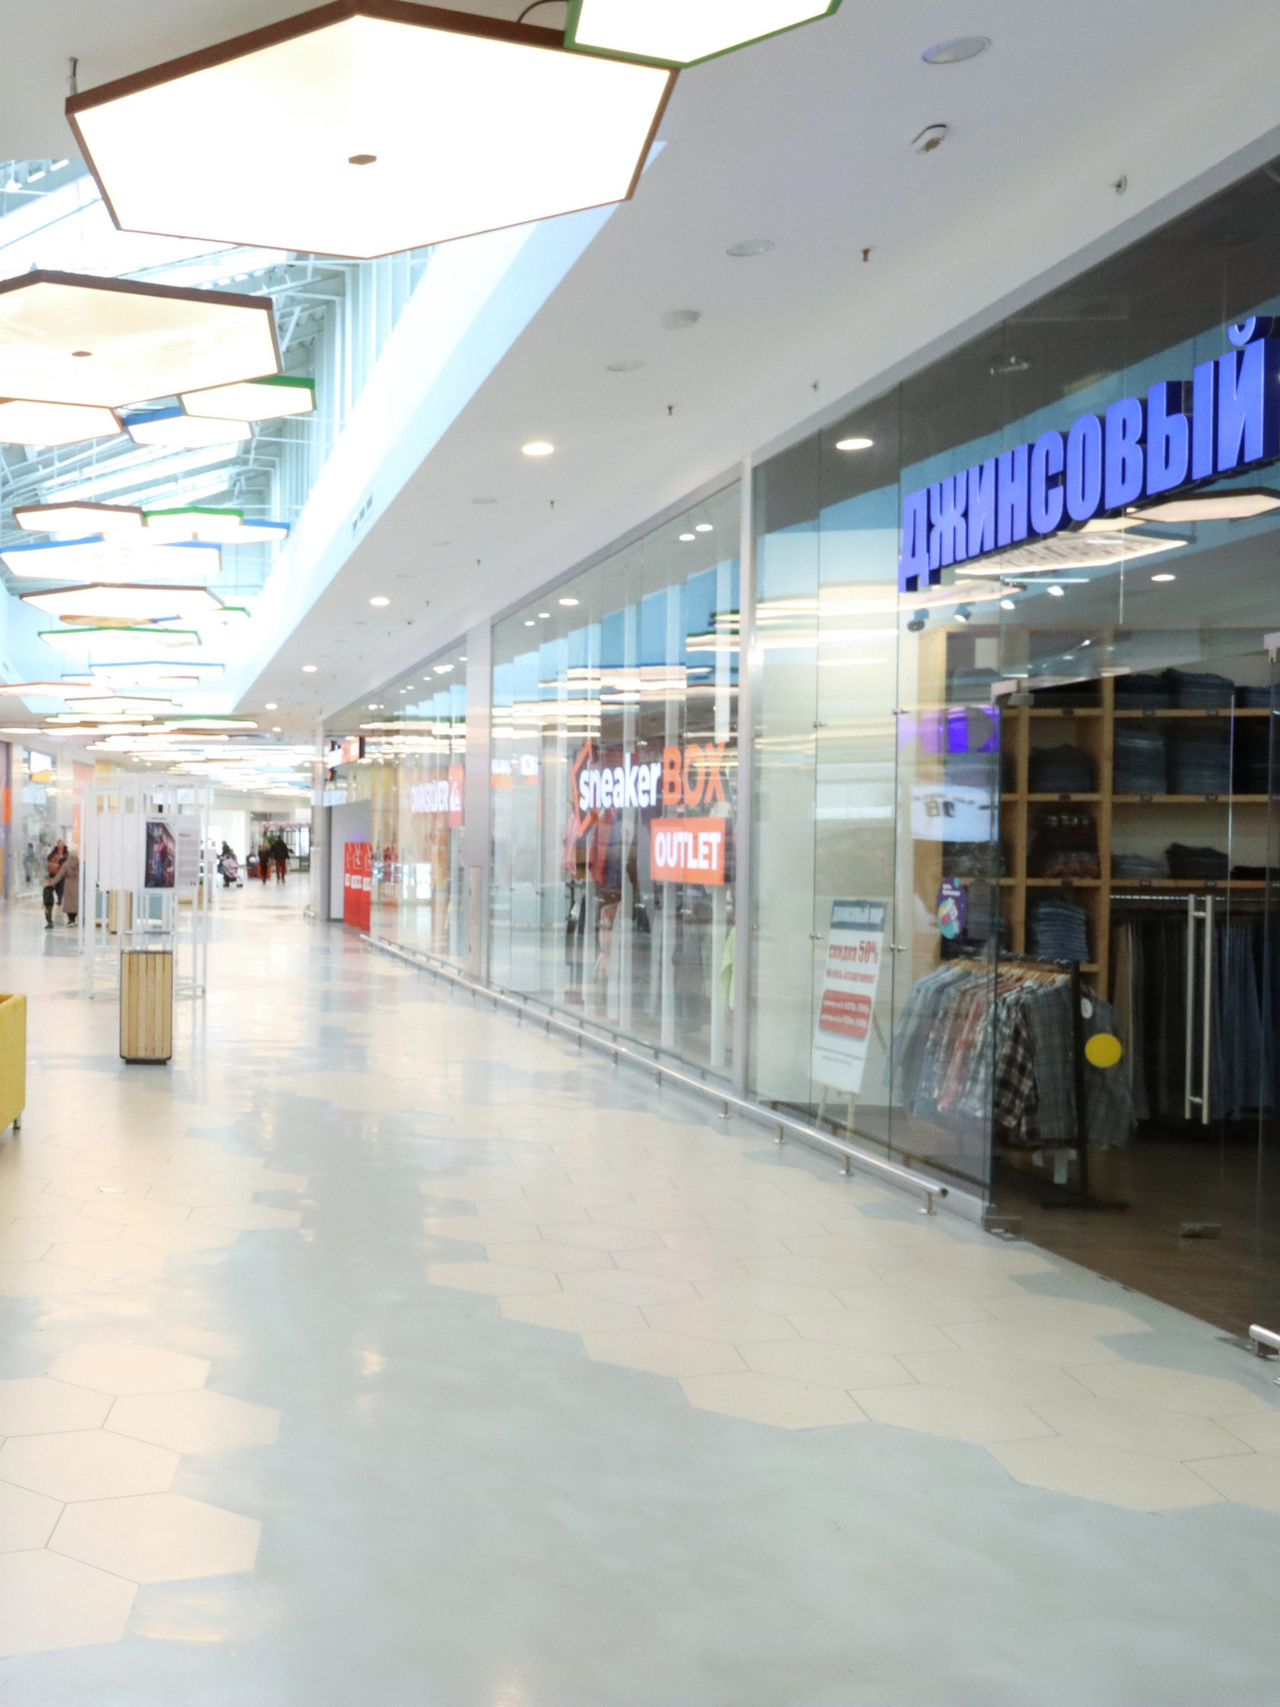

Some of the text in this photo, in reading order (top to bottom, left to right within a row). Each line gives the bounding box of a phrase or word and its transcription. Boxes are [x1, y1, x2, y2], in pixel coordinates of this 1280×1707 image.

[897, 315, 1267, 593] ДЖИНСОВЫЙ
[654, 831, 722, 871] OUTLET
[858, 940, 879, 965] 50%
